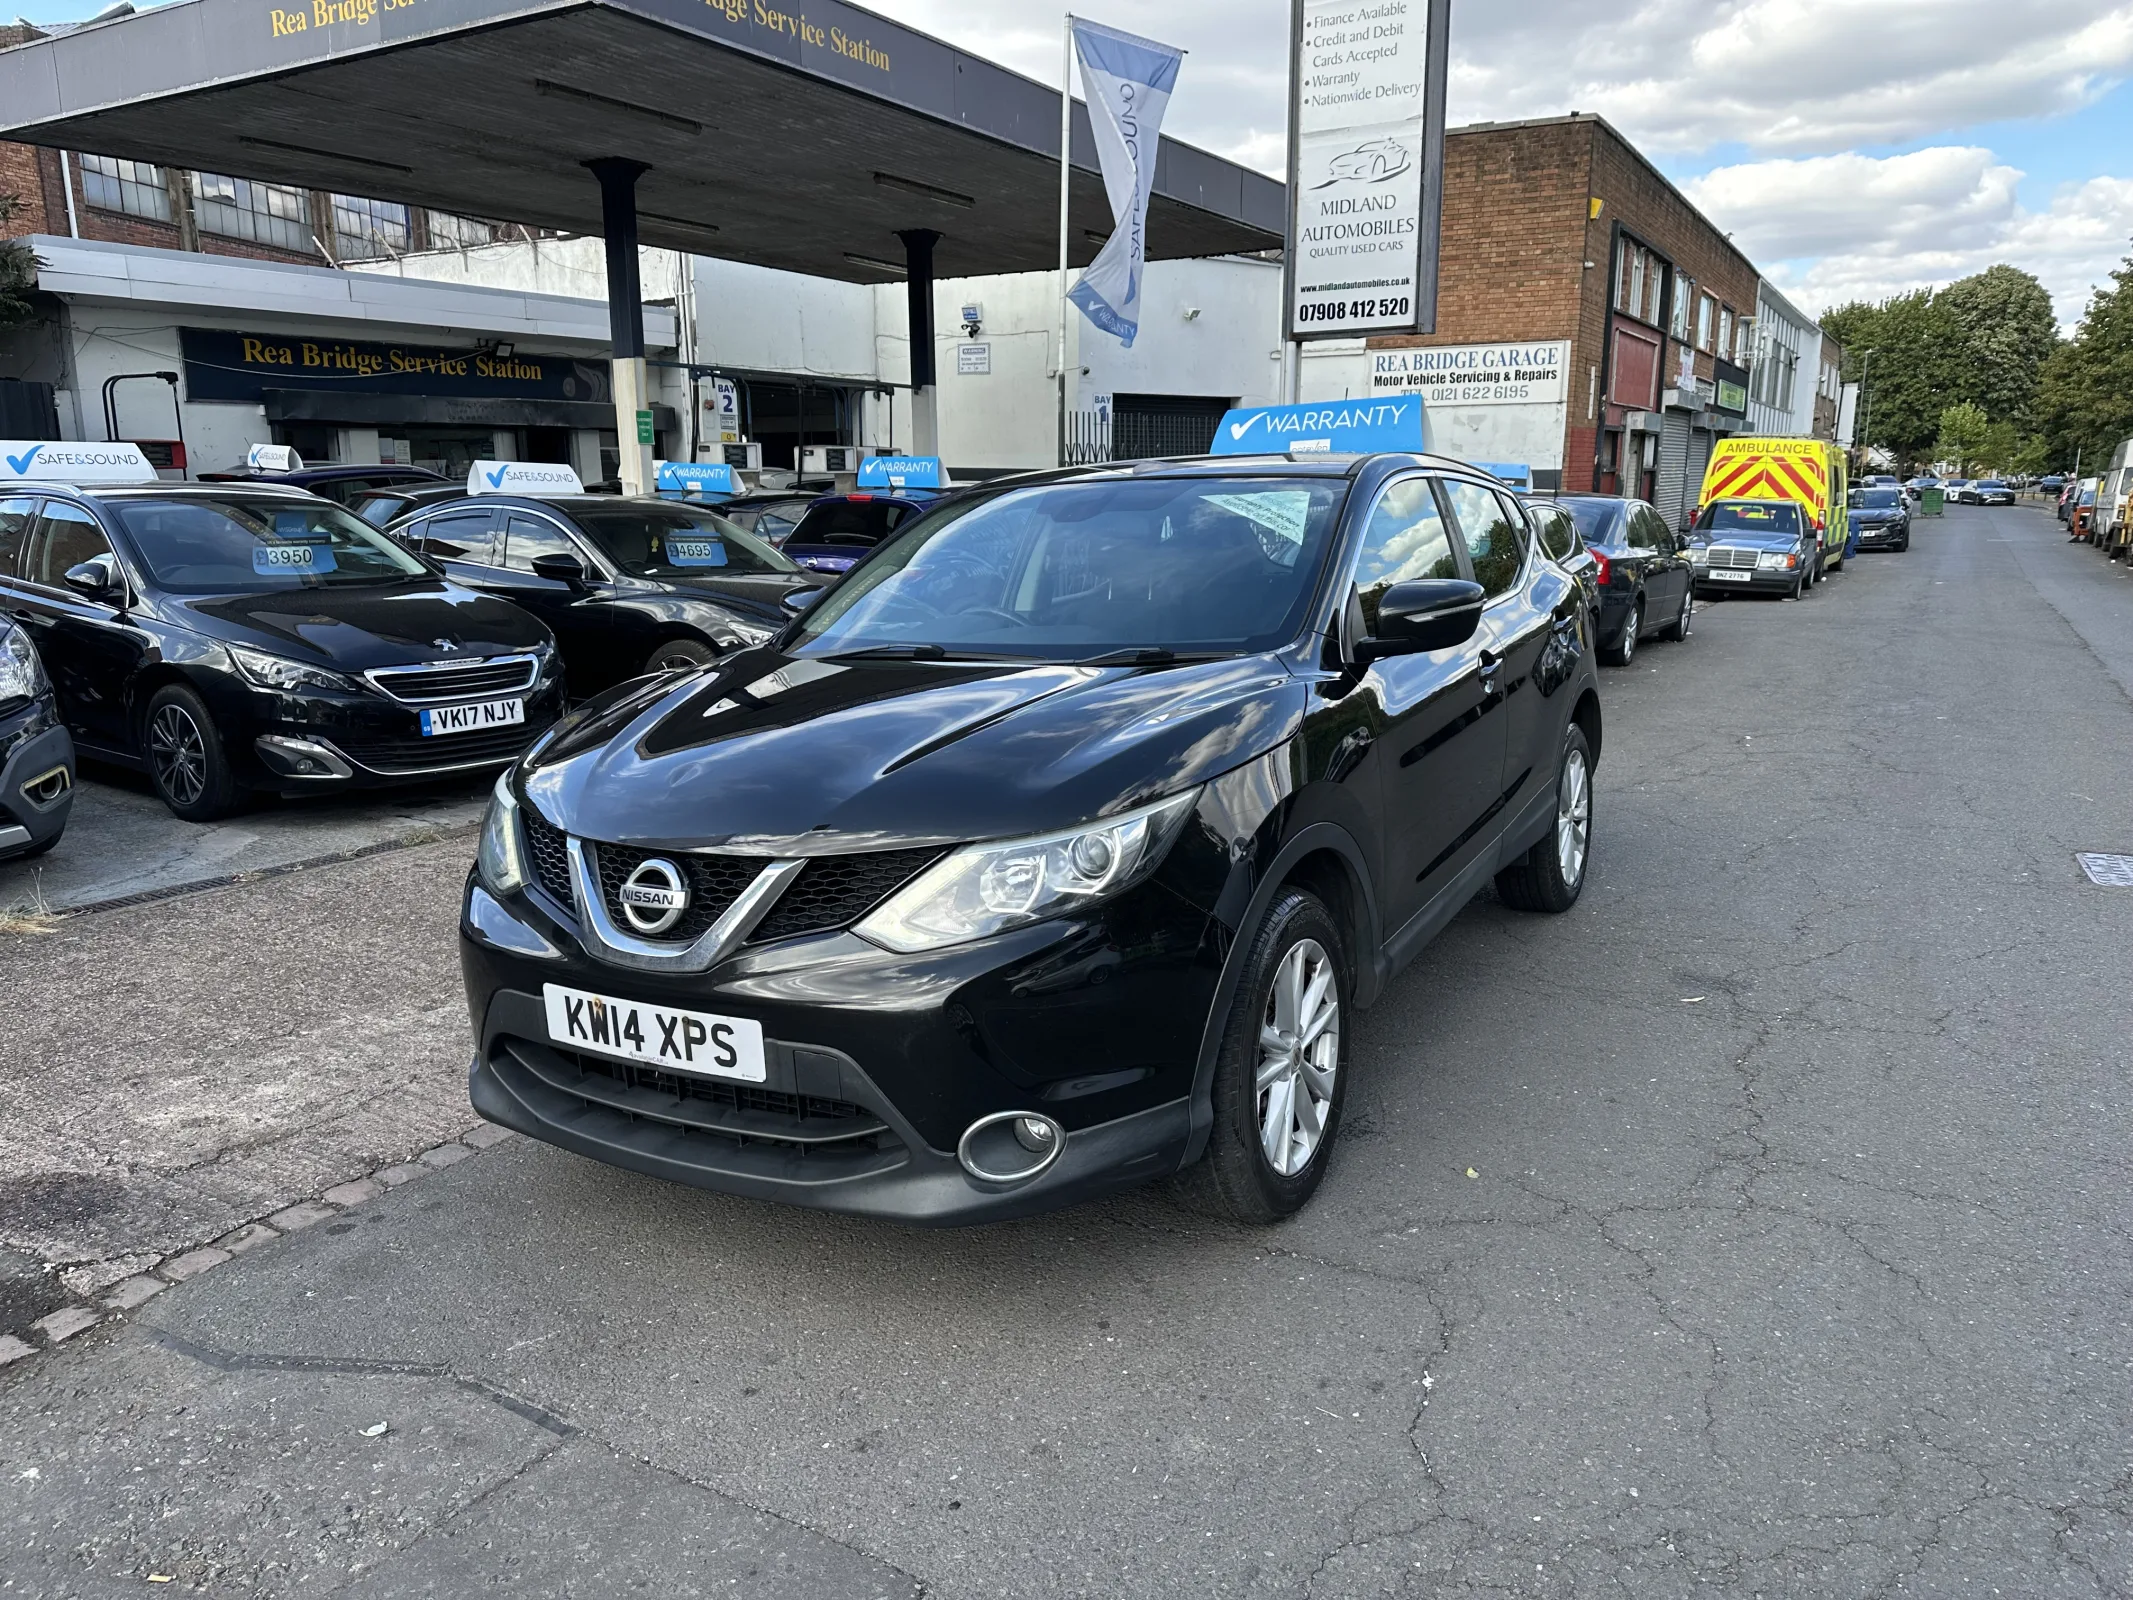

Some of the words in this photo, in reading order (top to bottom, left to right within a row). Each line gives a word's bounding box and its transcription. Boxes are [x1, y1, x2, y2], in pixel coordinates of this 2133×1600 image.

[270, 10, 307, 37] Rea
[313, 0, 377, 26] Bridge
[1314, 13, 1354, 28] Finance
[1357, 2, 1407, 22] Available
[754, 0, 825, 47] Service
[830, 26, 890, 72] Station
[1313, 31, 1346, 48] Credit
[1350, 27, 1370, 42] and
[1373, 23, 1404, 38] Debit
[1312, 52, 1343, 68] Cards
[1346, 43, 1398, 63] Accepted
[1312, 71, 1361, 88] Warranty
[1311, 88, 1372, 107] Nationwide
[1375, 83, 1421, 98] Delivery
[1320, 194, 1397, 216] MIDLAND
[1301, 217, 1415, 243] AUTOMOBILES
[1309, 245, 1349, 259] QUALITY
[1351, 243, 1377, 254] USED
[1378, 240, 1404, 252] CARS
[1300, 276, 1410, 293] www.midlandautomobiles.co.uk
[1300, 302, 1346, 322] 07908
[1349, 299, 1376, 318] 412
[1379, 297, 1409, 316] 520
[242, 338, 293, 365] Rea
[301, 343, 383, 376] Bridge
[390, 350, 468, 376] Service
[476, 356, 542, 380] Station
[1375, 355, 1413, 373] REA
[1413, 351, 1479, 371] BRIDGE
[1482, 347, 1559, 368] GARAGE
[1374, 374, 1403, 387] Motor
[1406, 372, 1446, 385] Vehicle
[1449, 370, 1500, 384] Servicing
[1503, 371, 1511, 382] &
[1514, 369, 1557, 382] Repairs
[718, 384, 735, 393] BAY
[1431, 388, 1458, 401] 0121
[1462, 387, 1490, 399] 622
[1494, 384, 1529, 399] 6195
[723, 395, 733, 412] 2
[1094, 396, 1111, 404] BAY
[1099, 405, 1107, 422] 1
[1266, 404, 1408, 433] WARRANTY
[1726, 443, 1812, 454] AMBULANCE
[38, 453, 139, 466] SAFE&SOUND
[879, 461, 934, 473] WARRANTY
[505, 471, 574, 483] SAFE&SOUND
[676, 467, 727, 478] WARRANTY
[256, 549, 312, 565] £3950
[669, 544, 711, 557] £4695
[437, 706, 478, 729] VK17
[484, 701, 516, 723] NJY
[621, 888, 674, 906] NISSAN
[564, 995, 645, 1053] KW14
[655, 1013, 738, 1069] XPS
